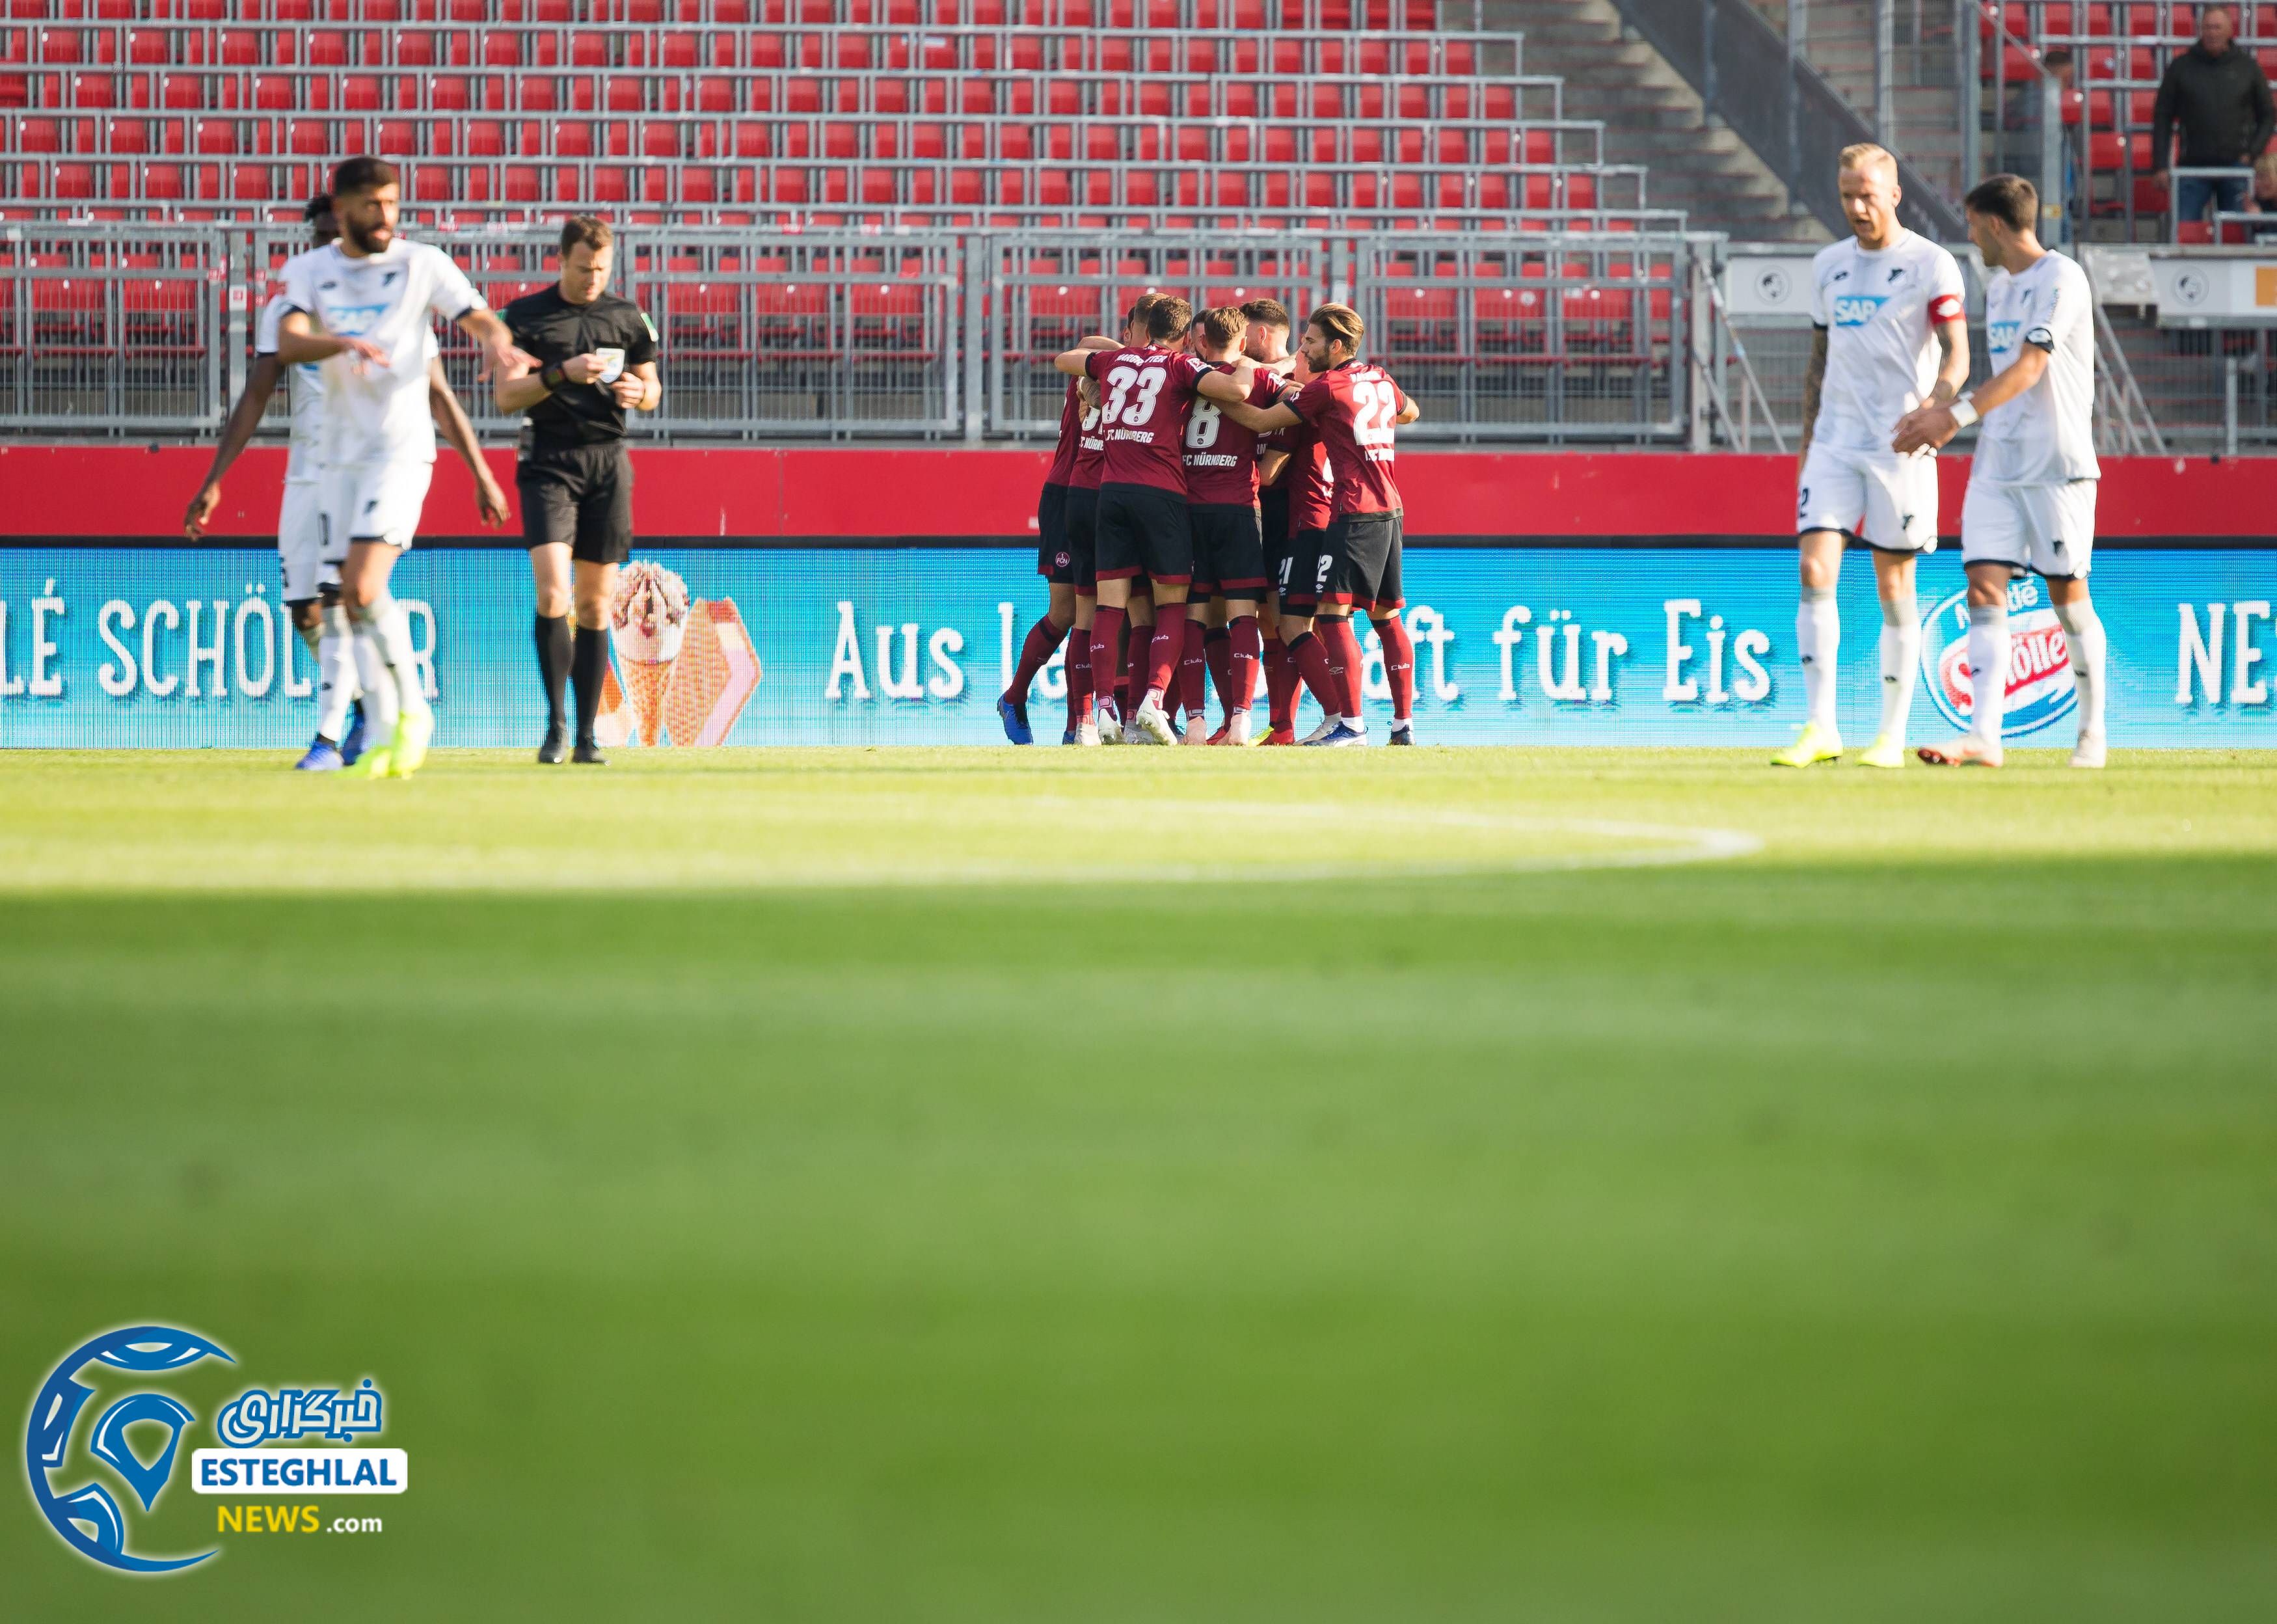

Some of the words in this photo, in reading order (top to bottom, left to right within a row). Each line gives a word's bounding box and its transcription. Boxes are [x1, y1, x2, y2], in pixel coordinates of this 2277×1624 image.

[1835, 299, 1878, 324] SAP
[1989, 325, 2016, 347] SAP
[1102, 366, 1166, 426] 33
[1185, 396, 1222, 448] 8
[1353, 381, 1397, 446] 22
[1114, 427, 1155, 444] NÜRNBERG
[1193, 452, 1238, 467] NÜRNBERG
[1317, 554, 1333, 582] 2
[825, 601, 964, 699] Aus
[1494, 605, 1628, 702] für
[1663, 599, 1770, 703] Eis
[1184, 657, 1202, 666] Club
[2175, 599, 2277, 705] NE
[1391, 663, 1410, 671] Club
